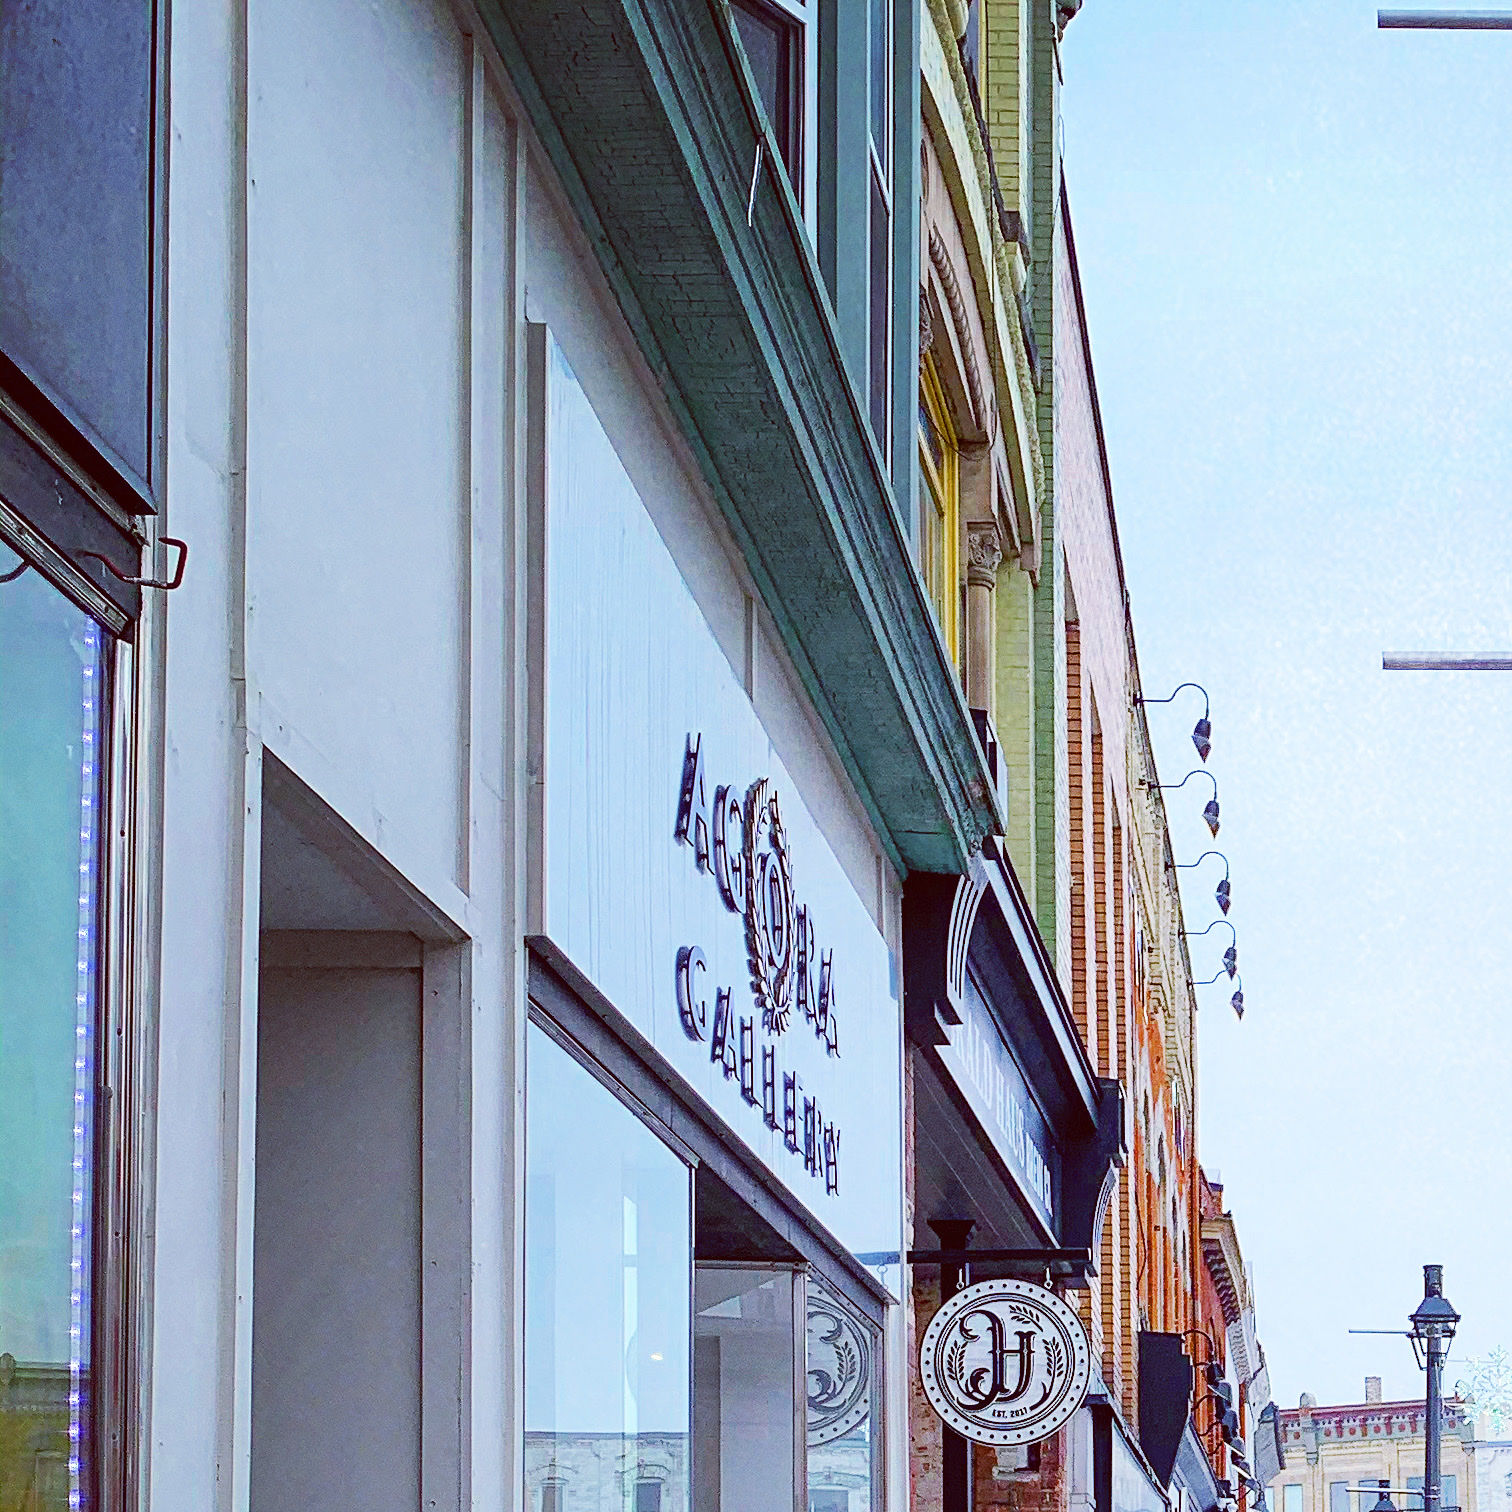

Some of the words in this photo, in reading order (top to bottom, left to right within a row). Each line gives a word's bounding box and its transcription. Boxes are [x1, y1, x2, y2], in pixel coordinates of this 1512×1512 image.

[674, 731, 841, 1059] AGORA
[674, 945, 841, 1197] GALLERY
[992, 1408, 1008, 1418] EST.
[1010, 1406, 1028, 1418] 2017
